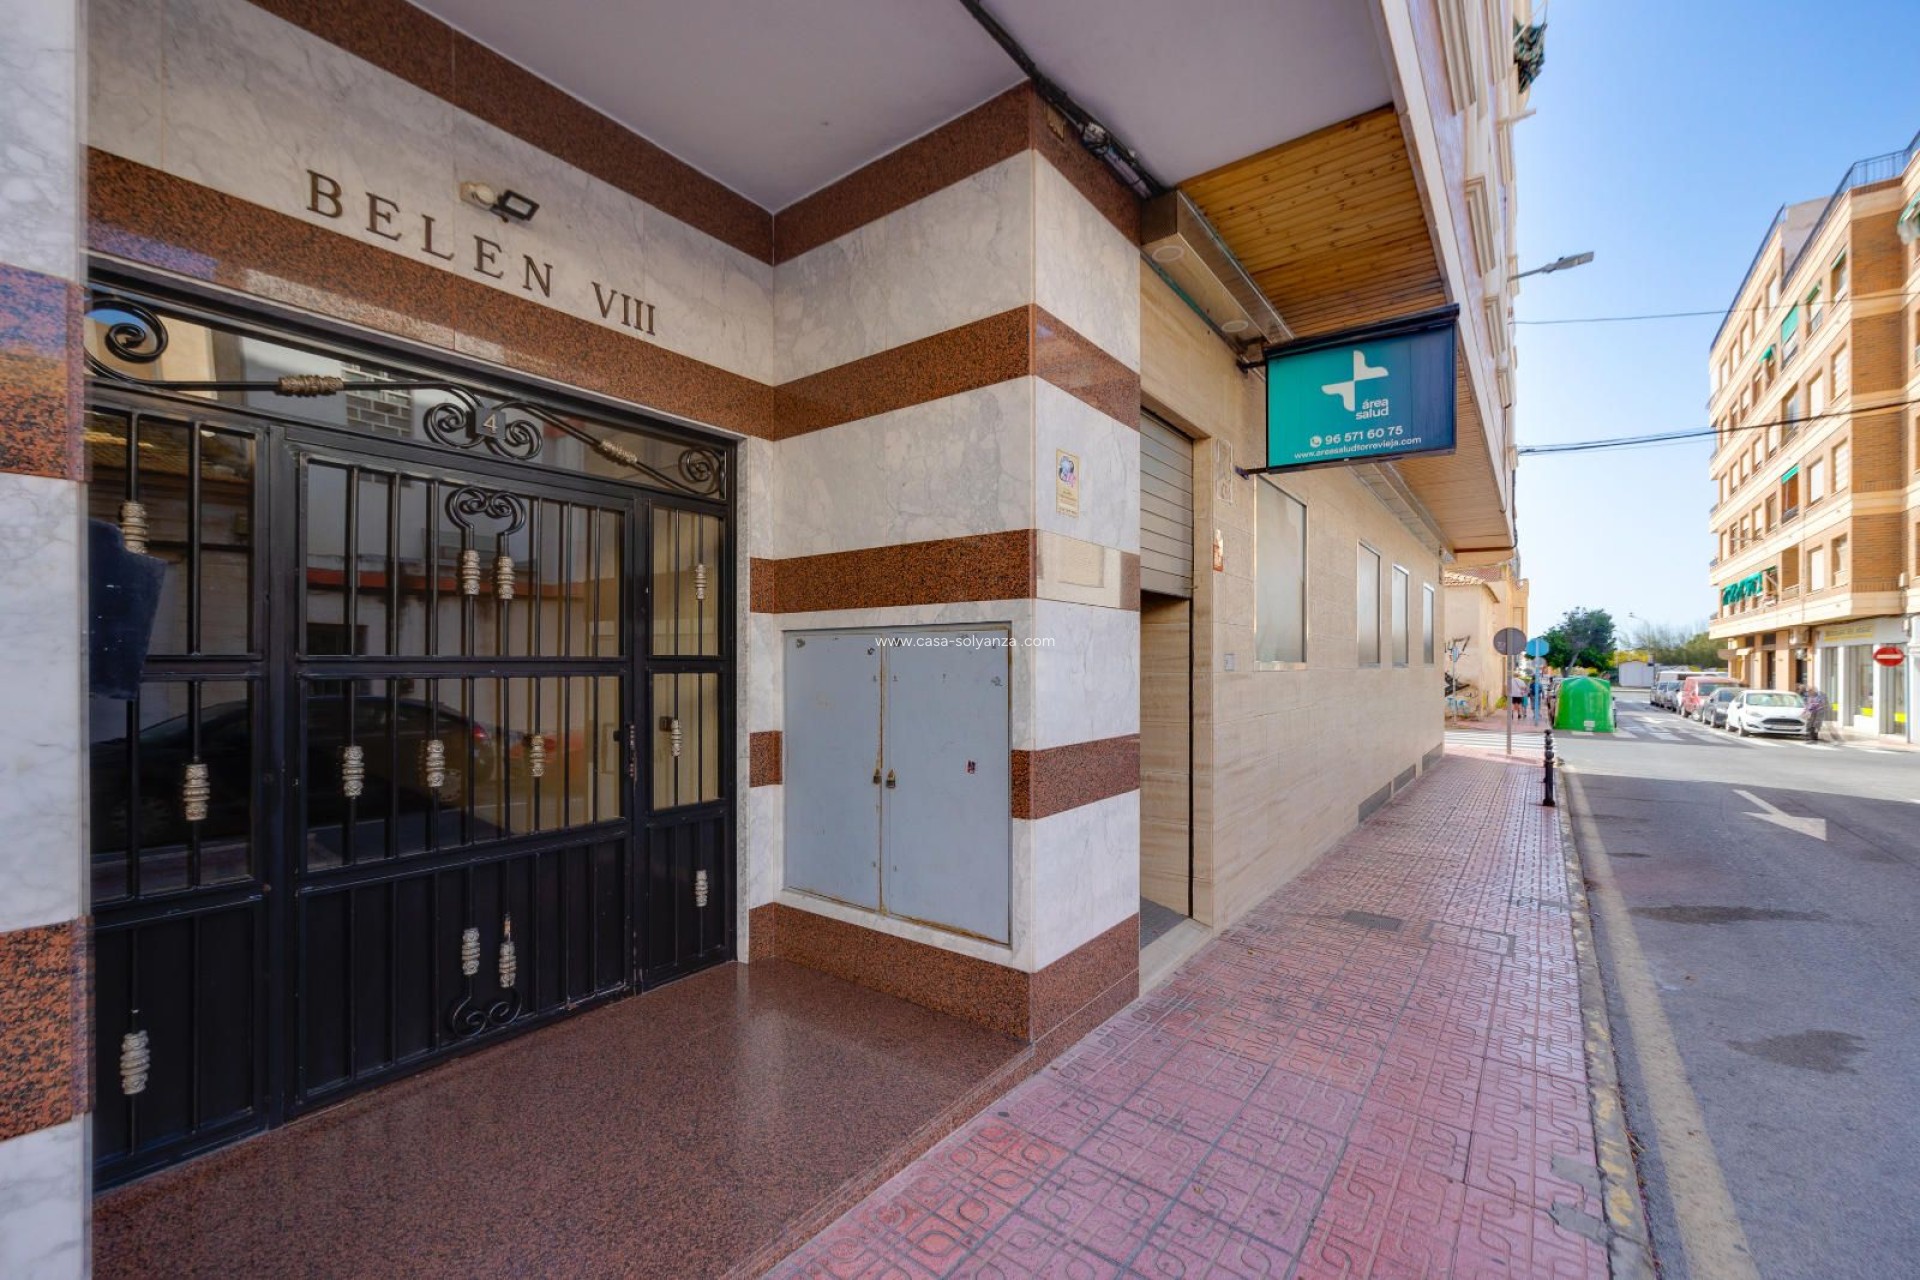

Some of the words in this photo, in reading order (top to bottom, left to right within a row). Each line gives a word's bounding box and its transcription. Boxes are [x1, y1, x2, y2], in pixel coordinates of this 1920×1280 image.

[306, 169, 553, 298] BELEN
[591, 281, 656, 336] VIII
[1355, 407, 1389, 420] salud
[1362, 398, 1389, 410] área
[483, 413, 498, 434] 4
[1325, 433, 1341, 445] 96
[1344, 430, 1364, 443] 571
[1367, 427, 1385, 439] 60
[1387, 425, 1404, 436] 75
